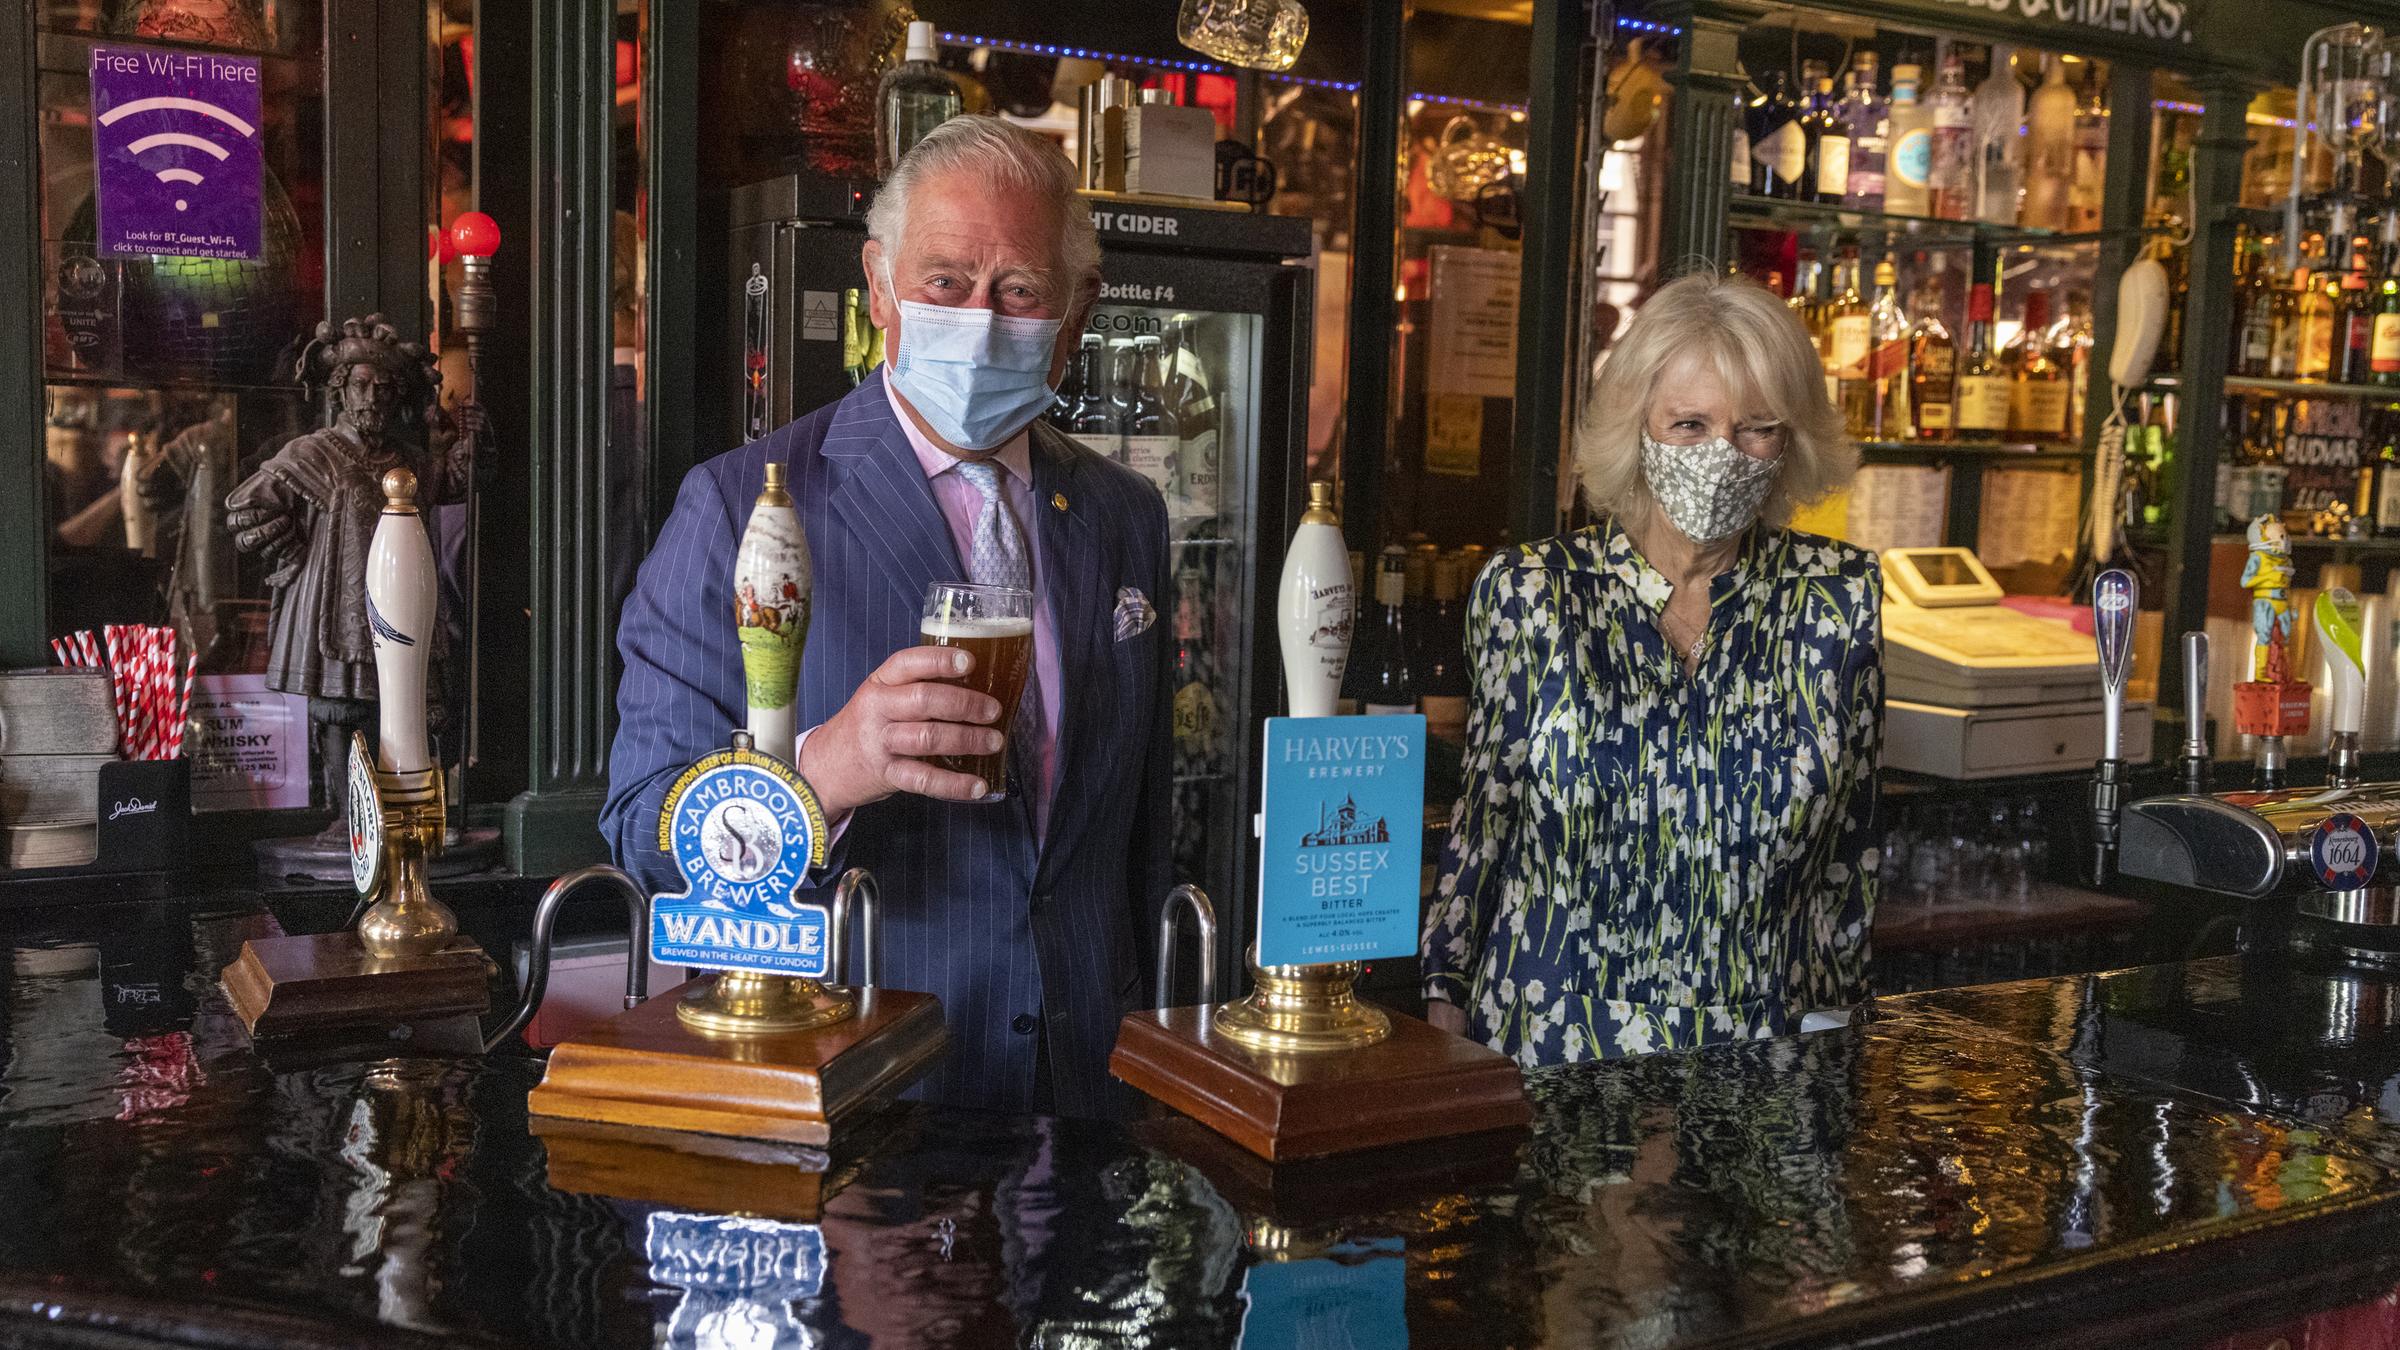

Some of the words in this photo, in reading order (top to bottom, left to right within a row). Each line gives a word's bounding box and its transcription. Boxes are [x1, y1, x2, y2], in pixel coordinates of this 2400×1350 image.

[94, 48, 139, 74] Free
[146, 53, 203, 78] Wi-Fi
[211, 58, 257, 83] here
[126, 230, 148, 241] Look
[150, 231, 162, 241] for
[1117, 213, 1179, 236] CIDER
[113, 242, 133, 252] click
[135, 244, 144, 253] to
[146, 245, 180, 254] connect
[182, 246, 198, 255] and
[199, 248, 214, 258] get
[1100, 282, 1152, 301] Bottle
[205, 718, 244, 732] RUM
[202, 734, 272, 748] WHISKY
[1285, 735, 1410, 763] HARVEY'S
[697, 754, 720, 775] BEER
[719, 752, 734, 765] OF
[734, 751, 771, 769] BRITAIN
[770, 761, 793, 782] 2014
[1308, 765, 1385, 779] BREWERY
[664, 766, 699, 812] CHAMPION
[680, 775, 804, 846] SAMBROOK'S
[659, 810, 672, 851] BRONZE
[810, 812, 825, 865] CATEGORY
[1295, 849, 1390, 874] SUSSEX
[2329, 842, 2361, 866] 1664
[686, 854, 796, 905] BREWERY
[1311, 874, 1373, 898] BEST
[1321, 898, 1364, 911] BITTER
[659, 911, 822, 956] WANDLE
[1331, 929, 1351, 937] 4.0%
[661, 947, 699, 958] BREWED
[700, 950, 710, 960] IN
[711, 951, 728, 961] THE
[729, 953, 758, 964] HEART
[760, 954, 773, 965] OF
[774, 957, 818, 969] LONDON
